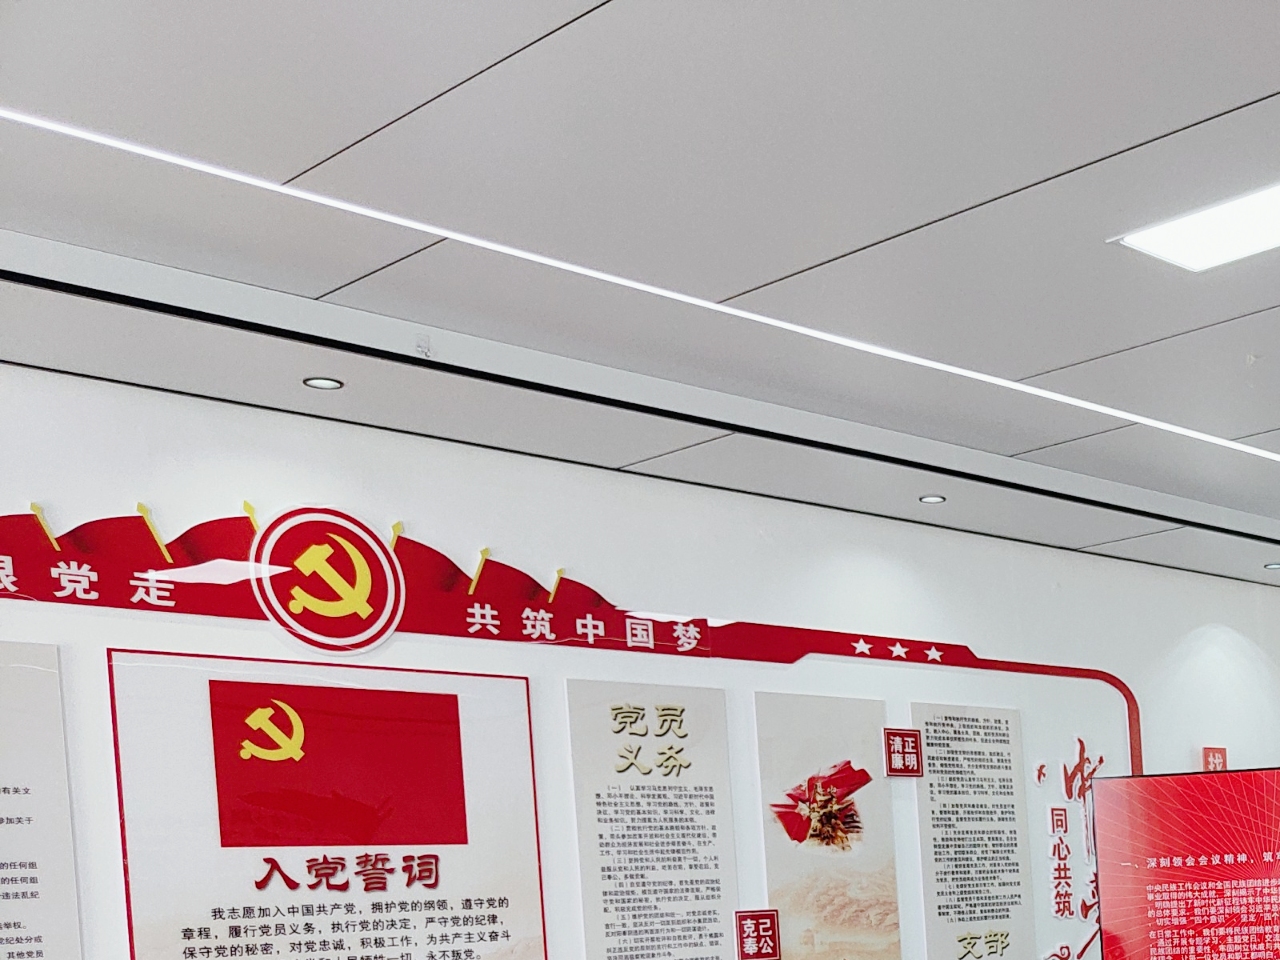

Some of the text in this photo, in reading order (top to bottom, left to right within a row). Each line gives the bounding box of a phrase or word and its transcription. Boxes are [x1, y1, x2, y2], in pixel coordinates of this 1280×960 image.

[466, 603, 701, 652] 共筑中国梦
[611, 703, 688, 738] 党员
[889, 736, 916, 752] 清正
[616, 744, 691, 777] 义务
[0, 786, 31, 795] 有关文
[254, 853, 440, 892] 入党誓词
[1050, 807, 1075, 918] 同心共筑
[0, 891, 39, 900] 违法乱纪
[211, 897, 509, 920] 我志愿加入中国共产党，拥护党的纲领，遵守党的
[0, 921, 27, 930] 举权。
[181, 914, 504, 941] 章程，履行党员义务，执行党的决定，严守党的纪律，
[741, 918, 773, 938] 克己
[182, 930, 511, 960] 保守党的秘密，对党忠诚，积极工作，为共产主义奋斗
[742, 937, 774, 956] 奉公
[956, 930, 1010, 960] 支部
